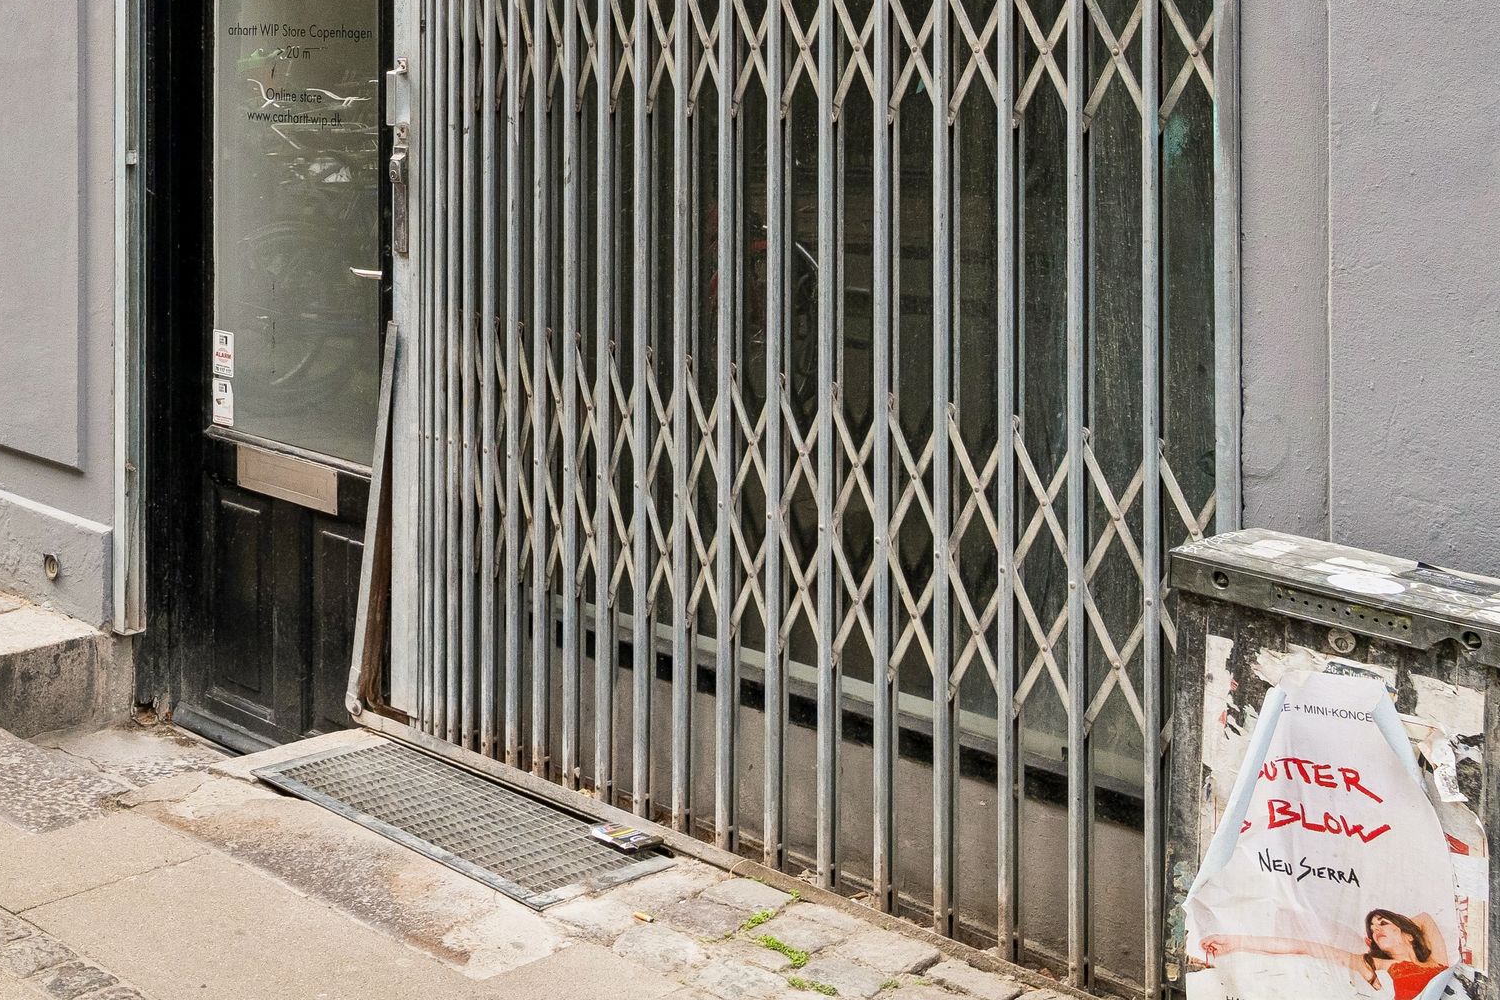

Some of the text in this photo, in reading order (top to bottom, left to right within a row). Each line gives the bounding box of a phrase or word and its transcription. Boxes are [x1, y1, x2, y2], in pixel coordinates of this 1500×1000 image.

[259, 23, 279, 37] WIP
[282, 24, 306, 38] Store
[309, 24, 373, 42] Copenhagen
[266, 87, 322, 104] Online store
[247, 110, 343, 130] www.carhartt-wip.dk
[1258, 757, 1384, 804] UTTER
